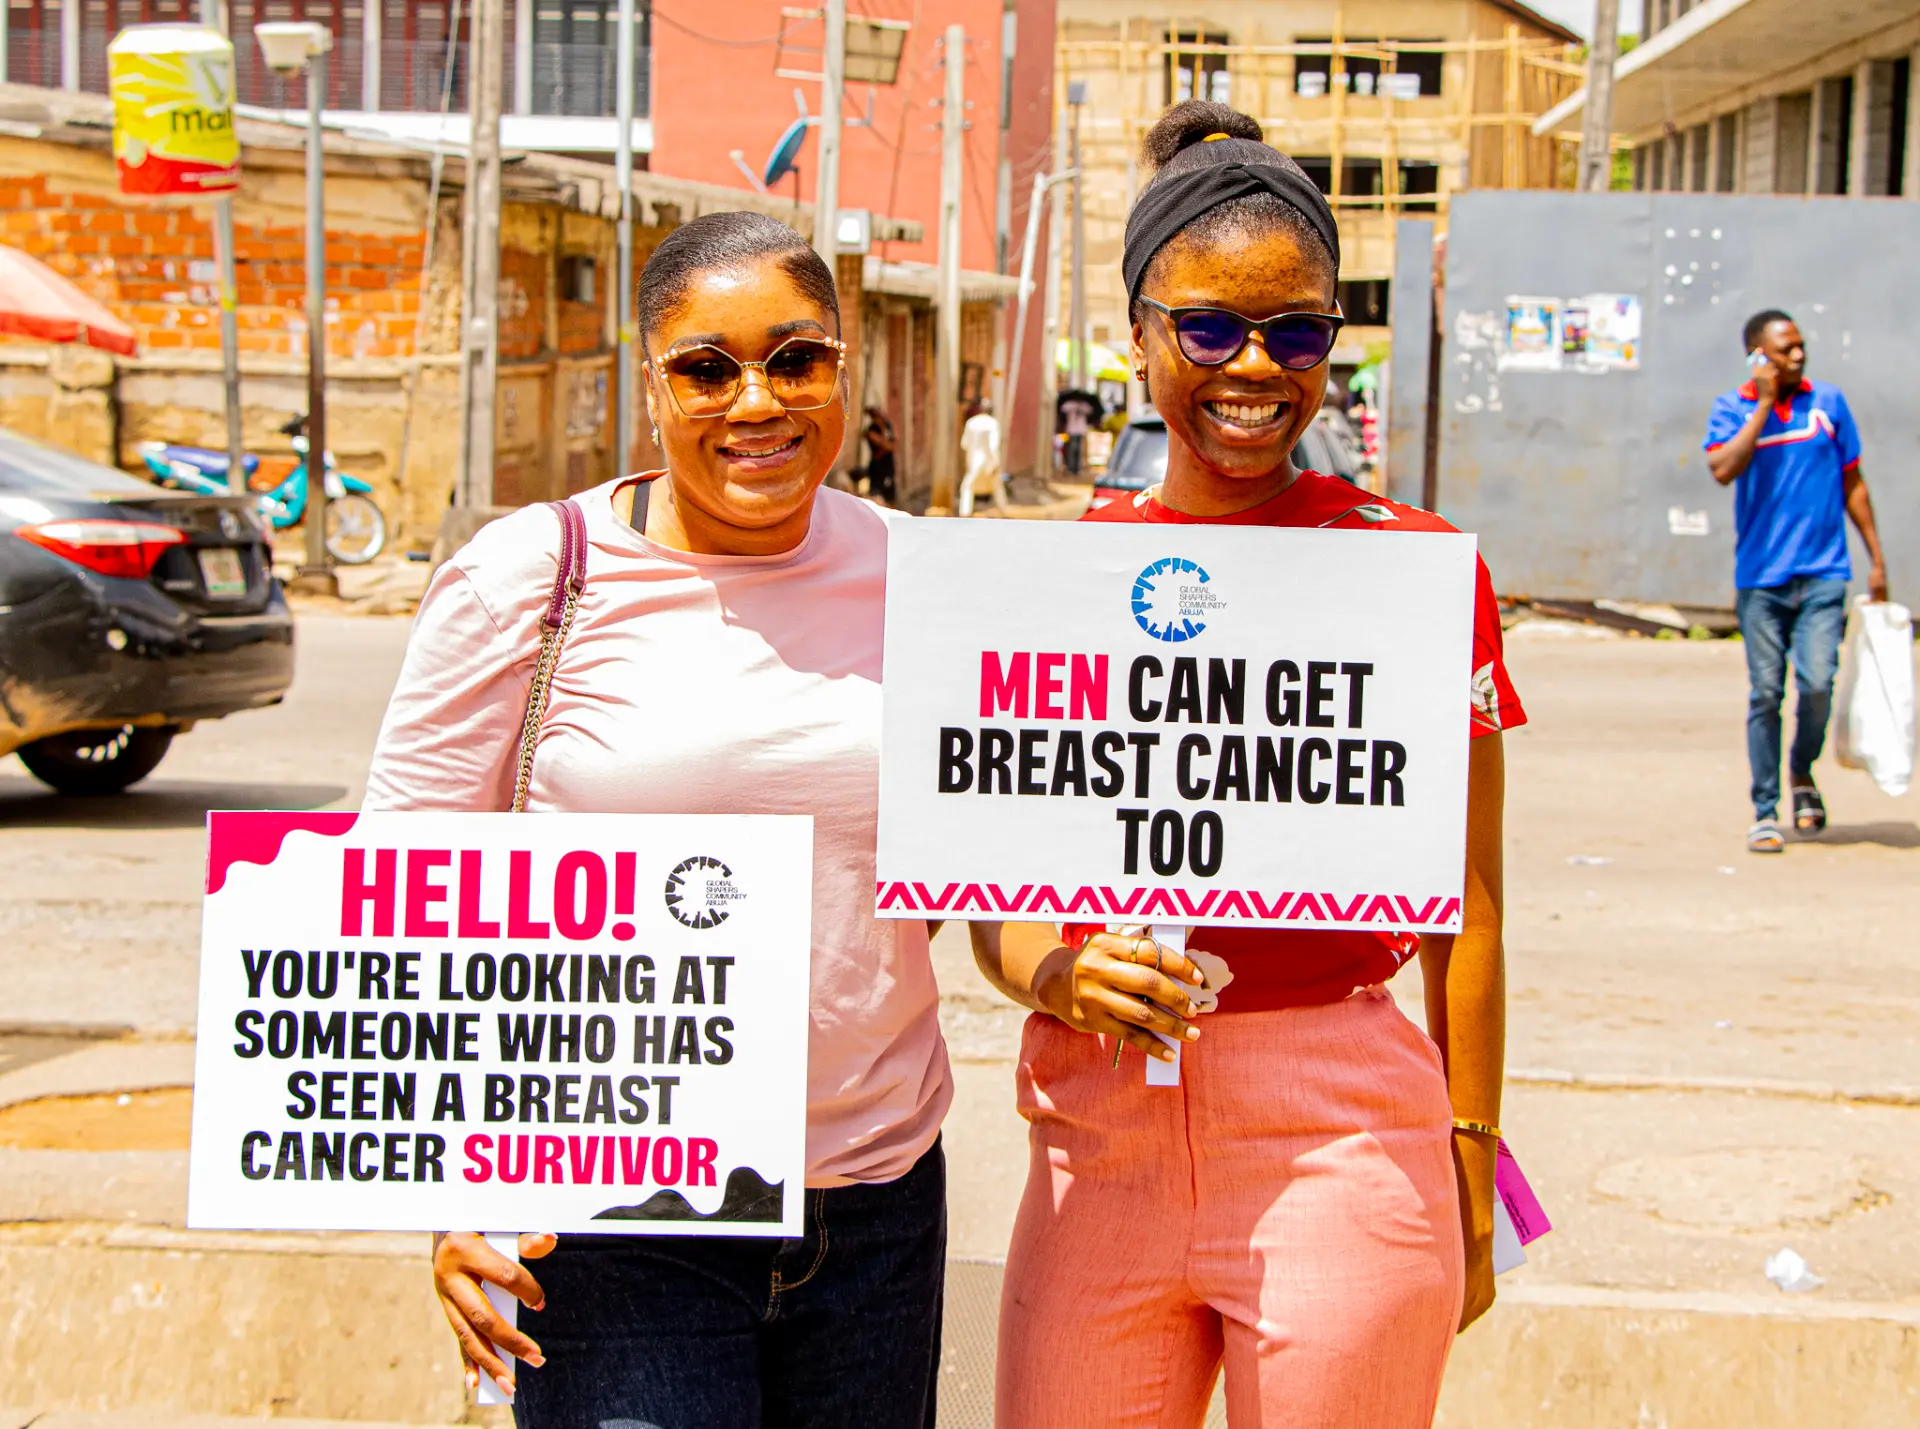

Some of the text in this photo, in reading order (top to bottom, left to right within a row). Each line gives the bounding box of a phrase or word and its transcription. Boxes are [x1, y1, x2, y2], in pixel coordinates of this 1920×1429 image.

[1179, 585, 1209, 593] GLOBAL
[1179, 593, 1216, 601] SHAPERS
[1179, 601, 1226, 609] COMMUNITY
[980, 651, 1374, 729] MEN CAN GET
[938, 727, 1407, 807] BREAST CANCER
[1116, 808, 1224, 878] TOO
[340, 848, 637, 942] HELLO!
[241, 949, 735, 1005] YOU'RE LOOKING AT
[234, 1010, 735, 1066] SOMEONE WHO HAS
[287, 1071, 681, 1125] SEEN A BREAST
[241, 1131, 719, 1187] CANCER SURVIVOR
